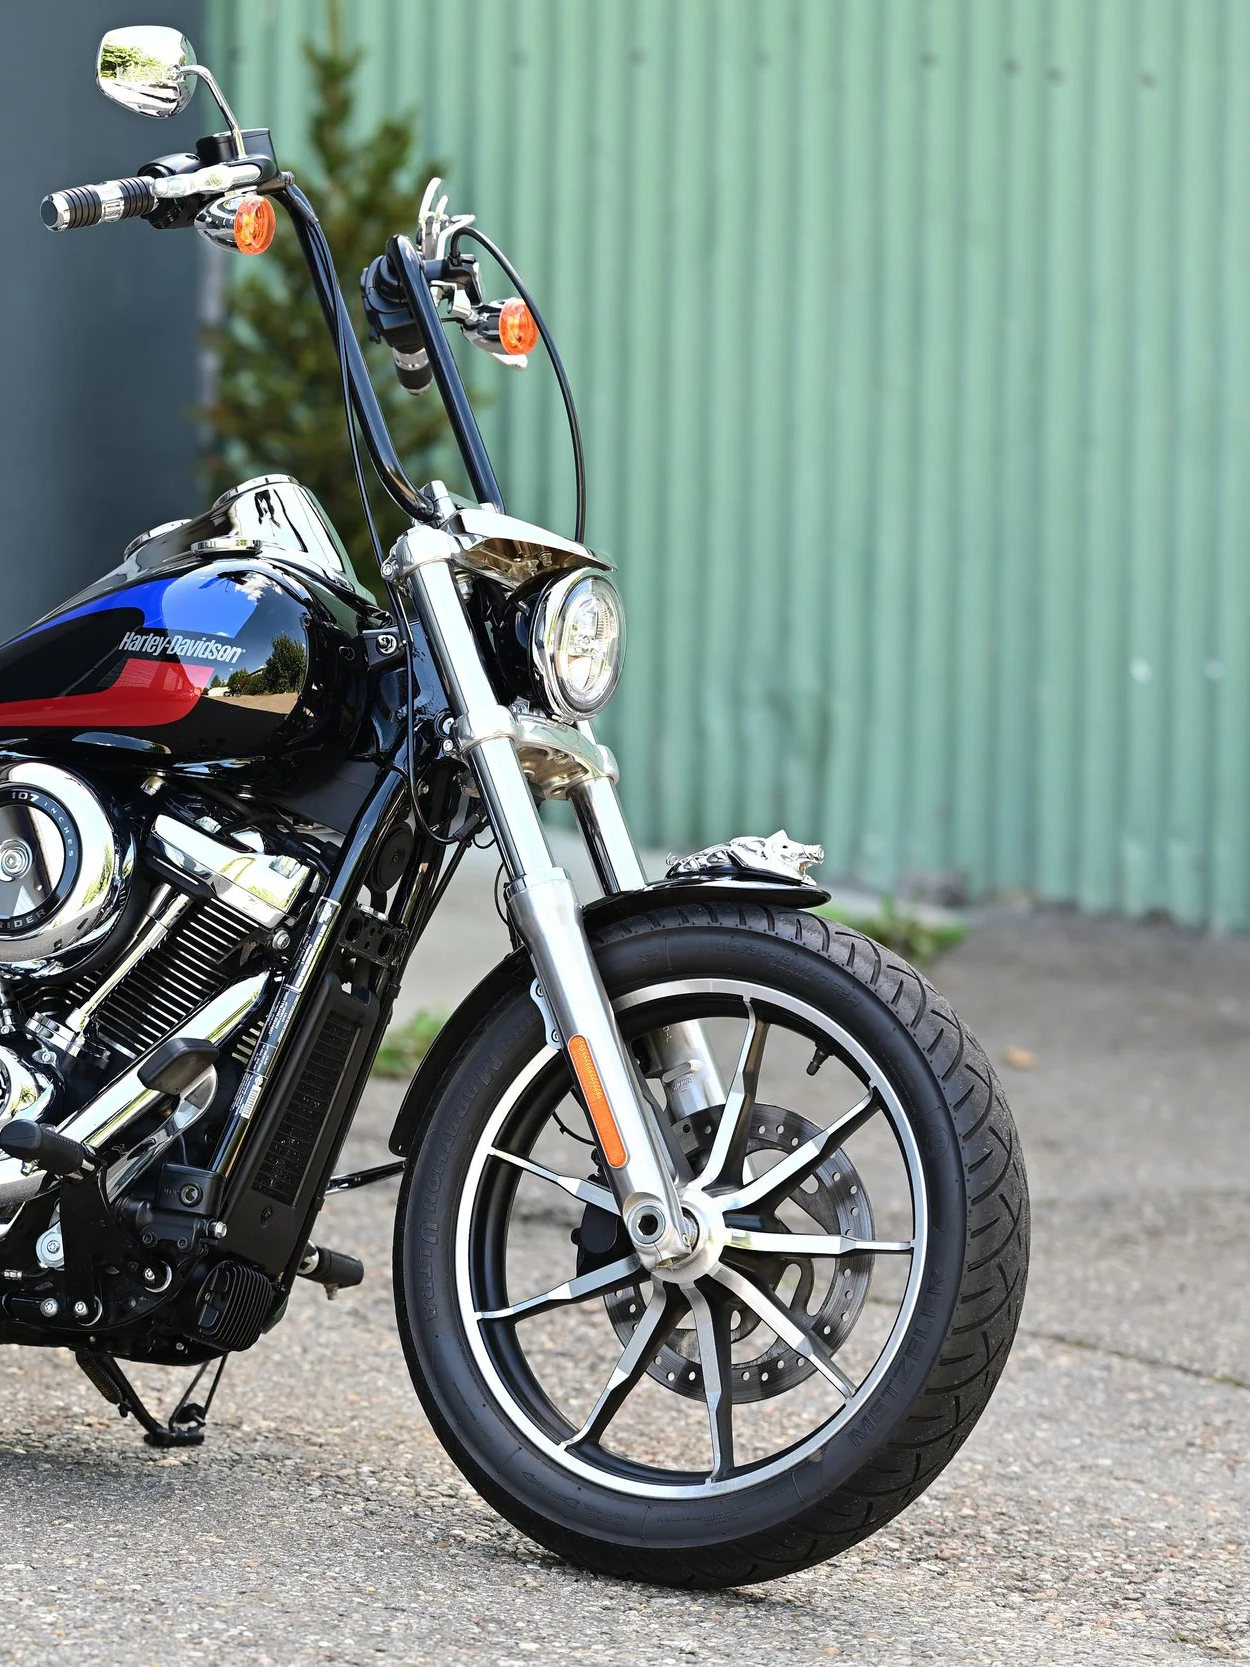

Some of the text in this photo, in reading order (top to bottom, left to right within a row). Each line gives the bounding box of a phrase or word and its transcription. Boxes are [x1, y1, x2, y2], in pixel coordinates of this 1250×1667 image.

[118, 632, 243, 663] Harley-Davidson
[11, 791, 40, 802] 107
[43, 802, 74, 857] INCHES
[417, 1218, 440, 1322] ULTRA
[846, 1267, 944, 1449] METZELER
